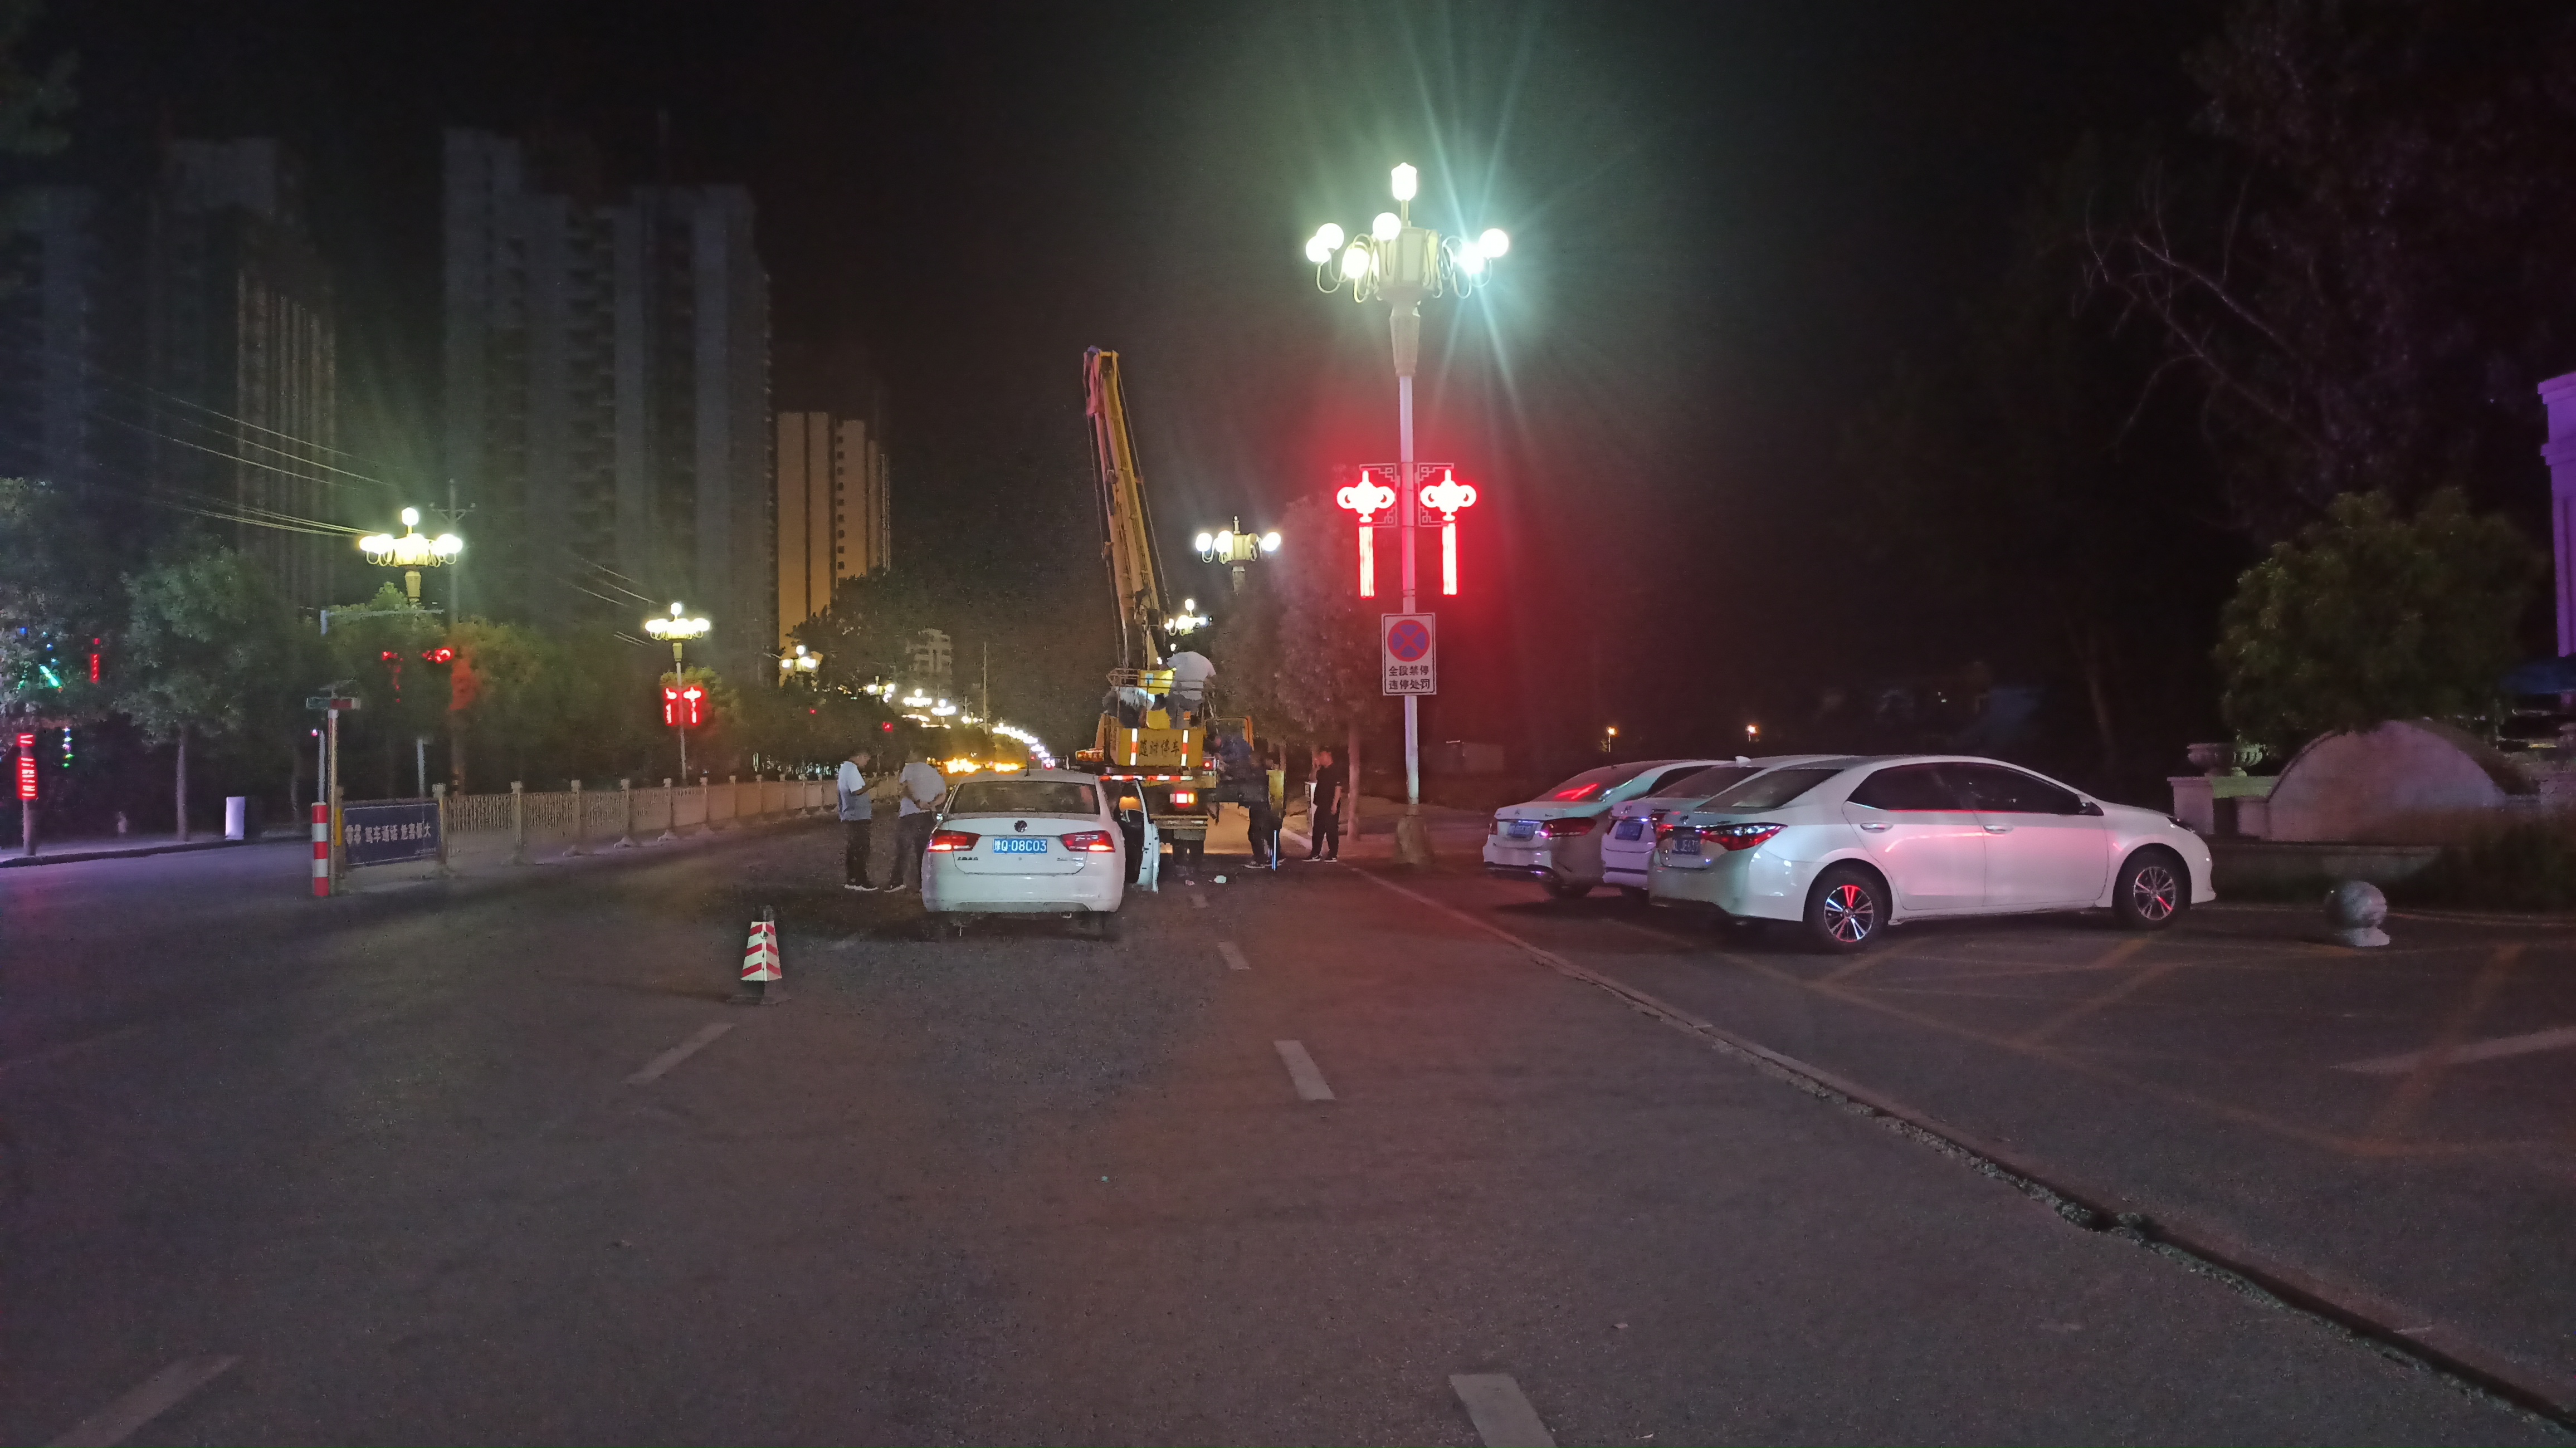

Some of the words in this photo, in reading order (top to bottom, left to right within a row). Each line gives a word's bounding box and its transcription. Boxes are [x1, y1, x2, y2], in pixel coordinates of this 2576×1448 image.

[1388, 665, 1429, 677] 全段禁停
[1388, 679, 1431, 691] 违停处罚
